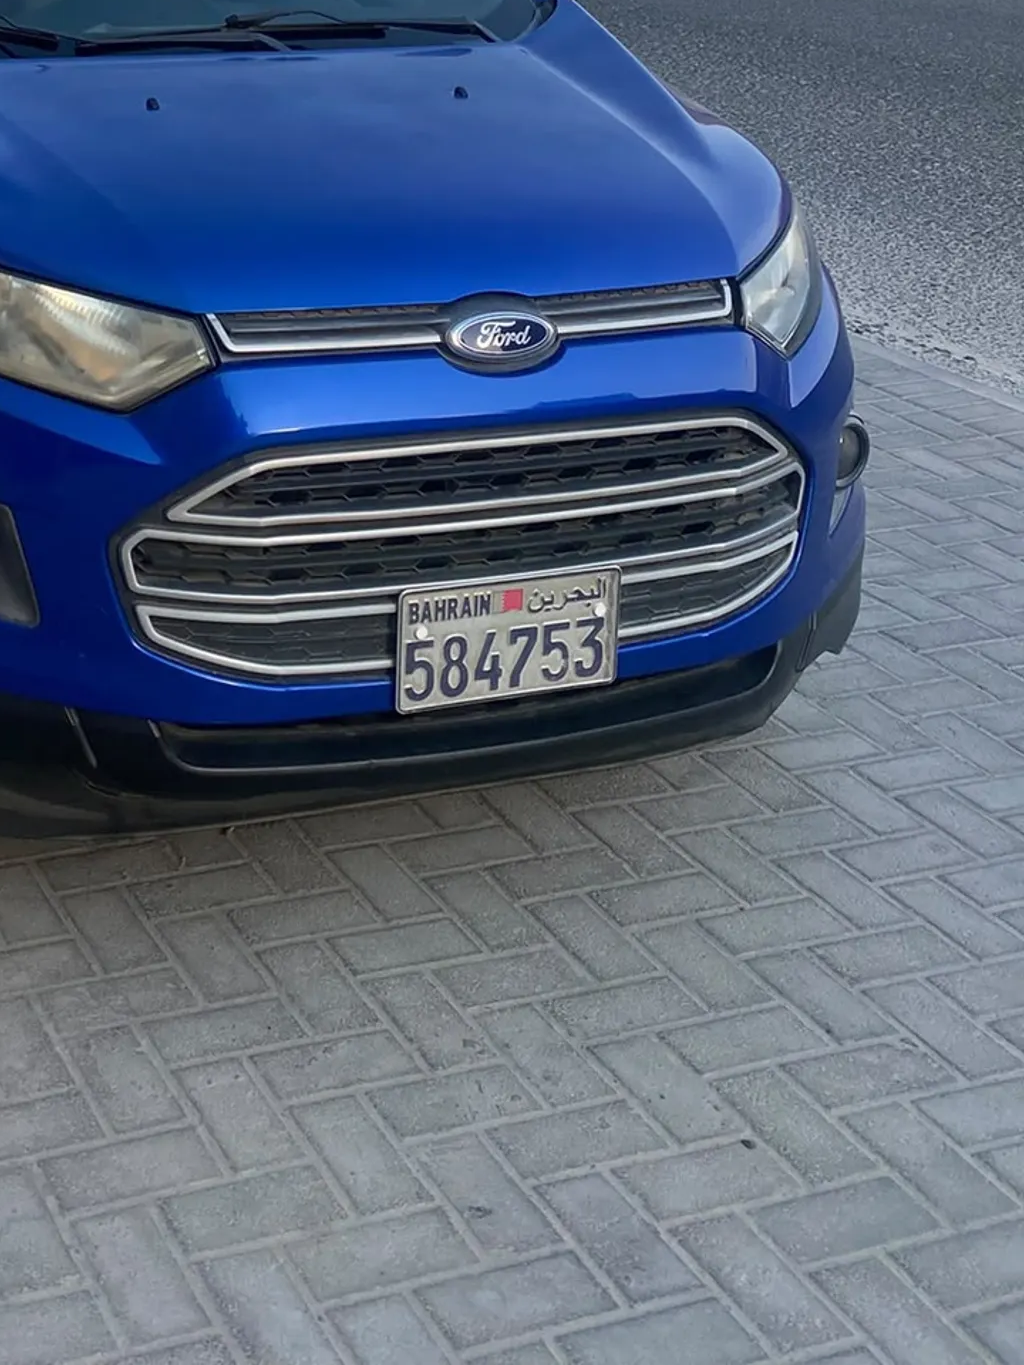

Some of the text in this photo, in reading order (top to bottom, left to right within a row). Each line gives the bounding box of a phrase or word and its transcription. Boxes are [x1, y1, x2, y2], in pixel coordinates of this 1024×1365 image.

[476, 320, 532, 349] Ford
[408, 592, 492, 624] BAHRAIN
[528, 577, 607, 613] البحرين
[405, 617, 605, 701] 584753
